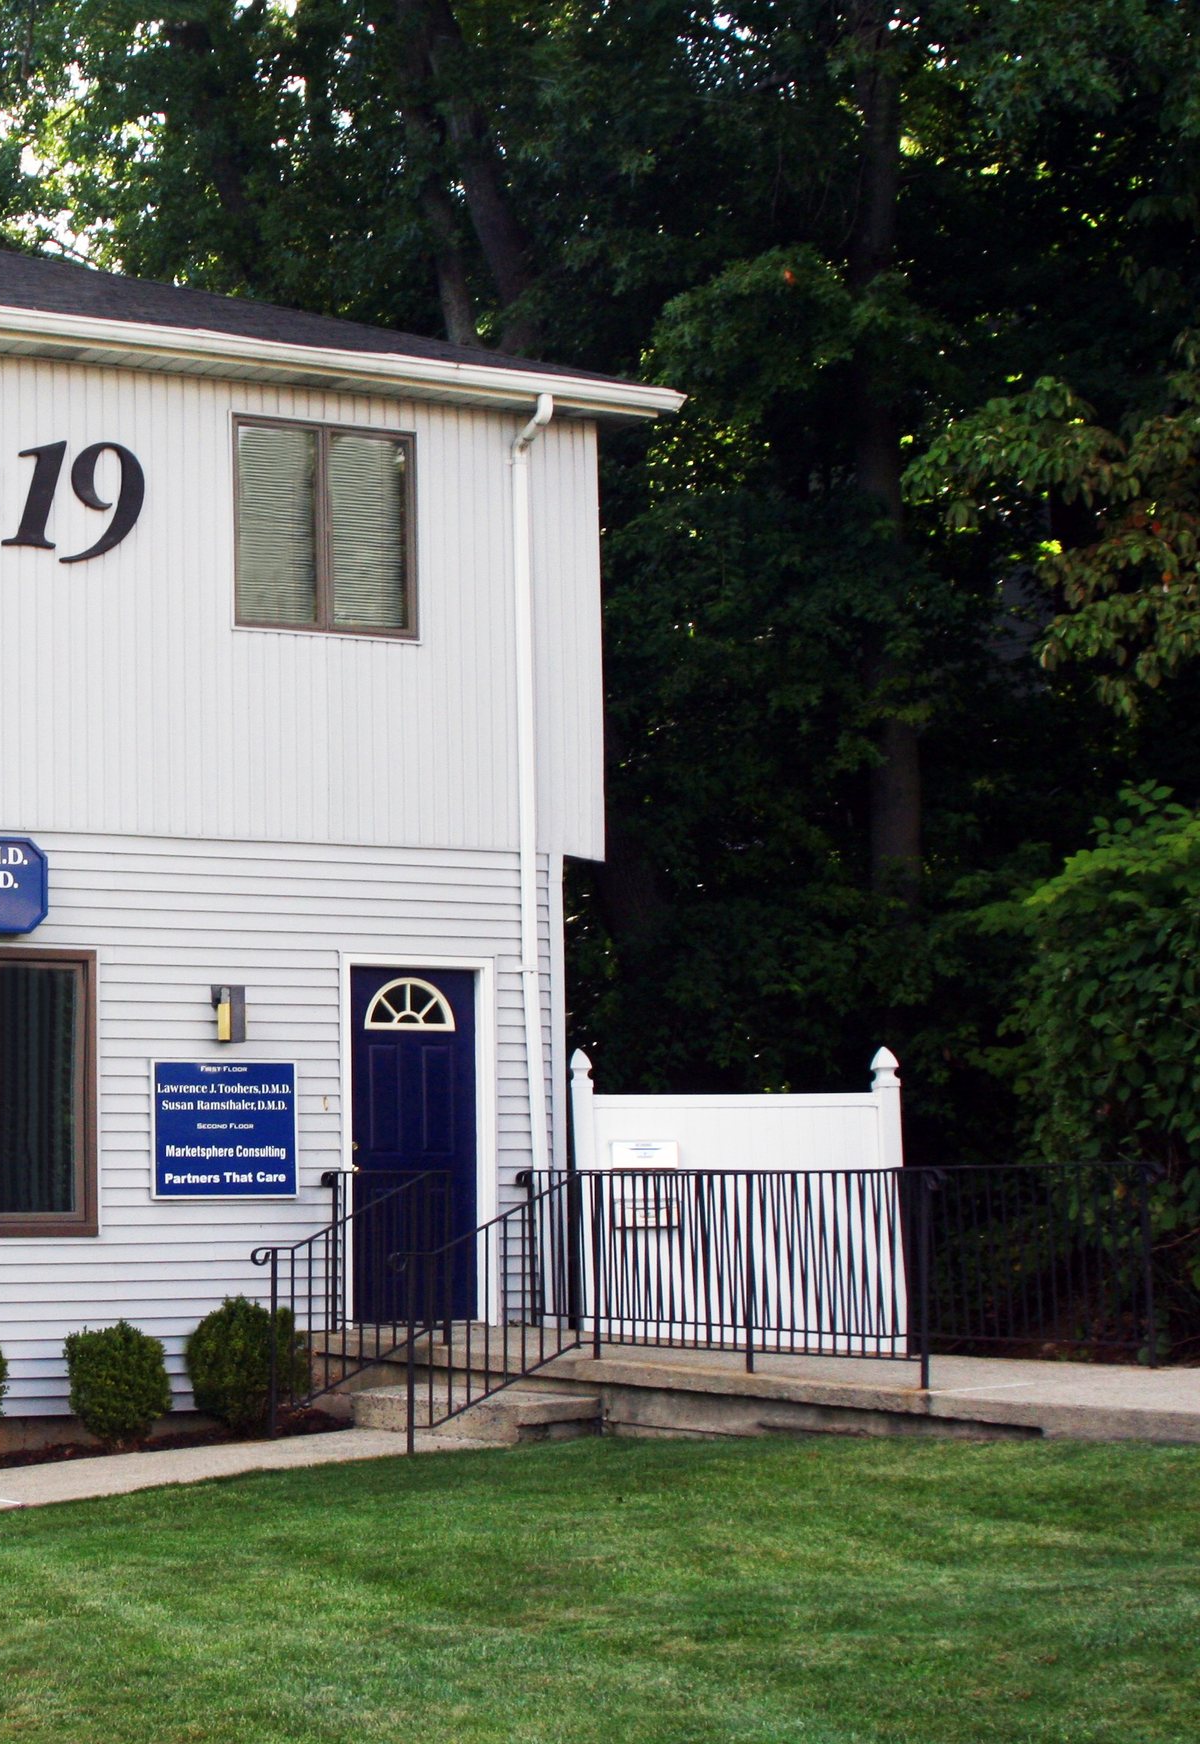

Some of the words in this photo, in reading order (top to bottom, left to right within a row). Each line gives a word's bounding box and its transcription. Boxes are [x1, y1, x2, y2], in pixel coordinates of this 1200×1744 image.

[157, 1083, 207, 1093] Lawrence
[209, 1084, 217, 1094] J.
[162, 1100, 193, 1110] Susan
[166, 1145, 234, 1159] Marketsphere
[236, 1145, 286, 1160] Consulting
[165, 1173, 220, 1184] Partners
[224, 1172, 253, 1183] That
[257, 1172, 286, 1182] Care
